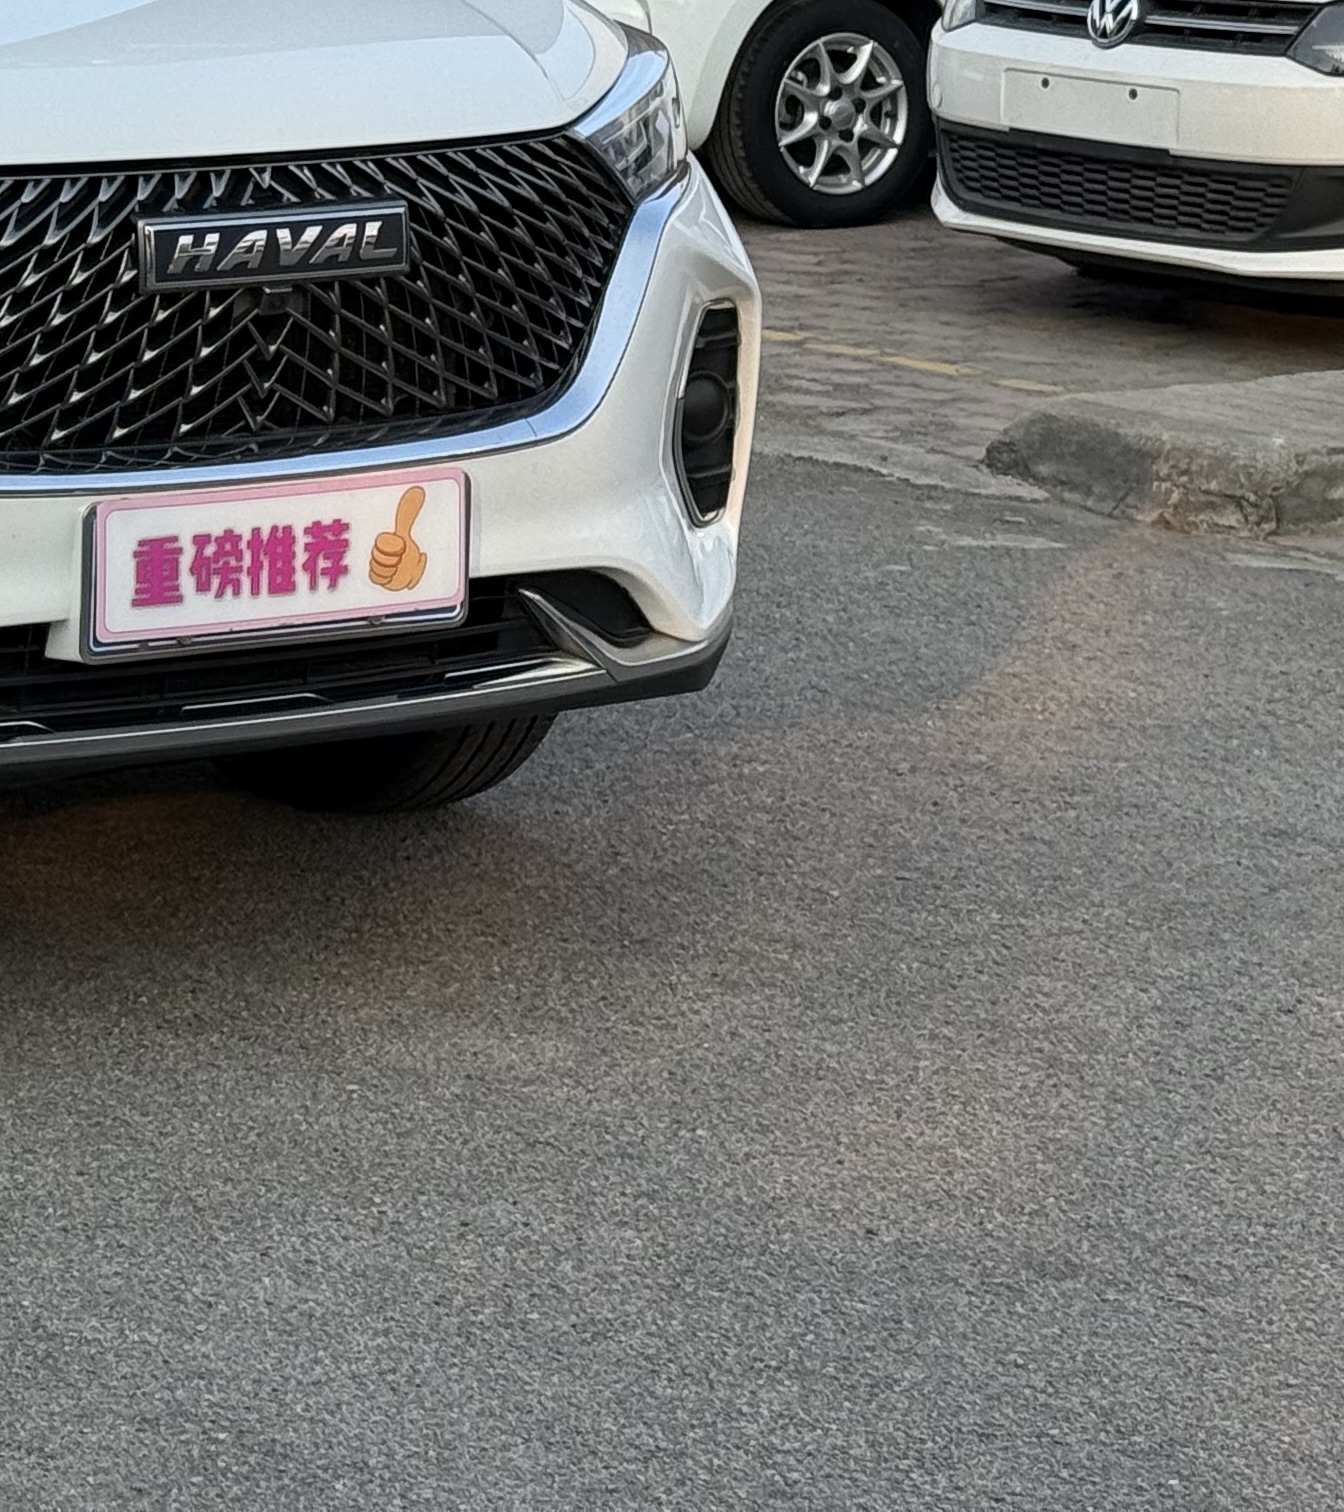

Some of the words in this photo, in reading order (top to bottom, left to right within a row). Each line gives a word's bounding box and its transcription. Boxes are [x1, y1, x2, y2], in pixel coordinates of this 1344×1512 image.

[166, 219, 399, 276] HAVAL
[130, 517, 352, 610] 重磅推荐
